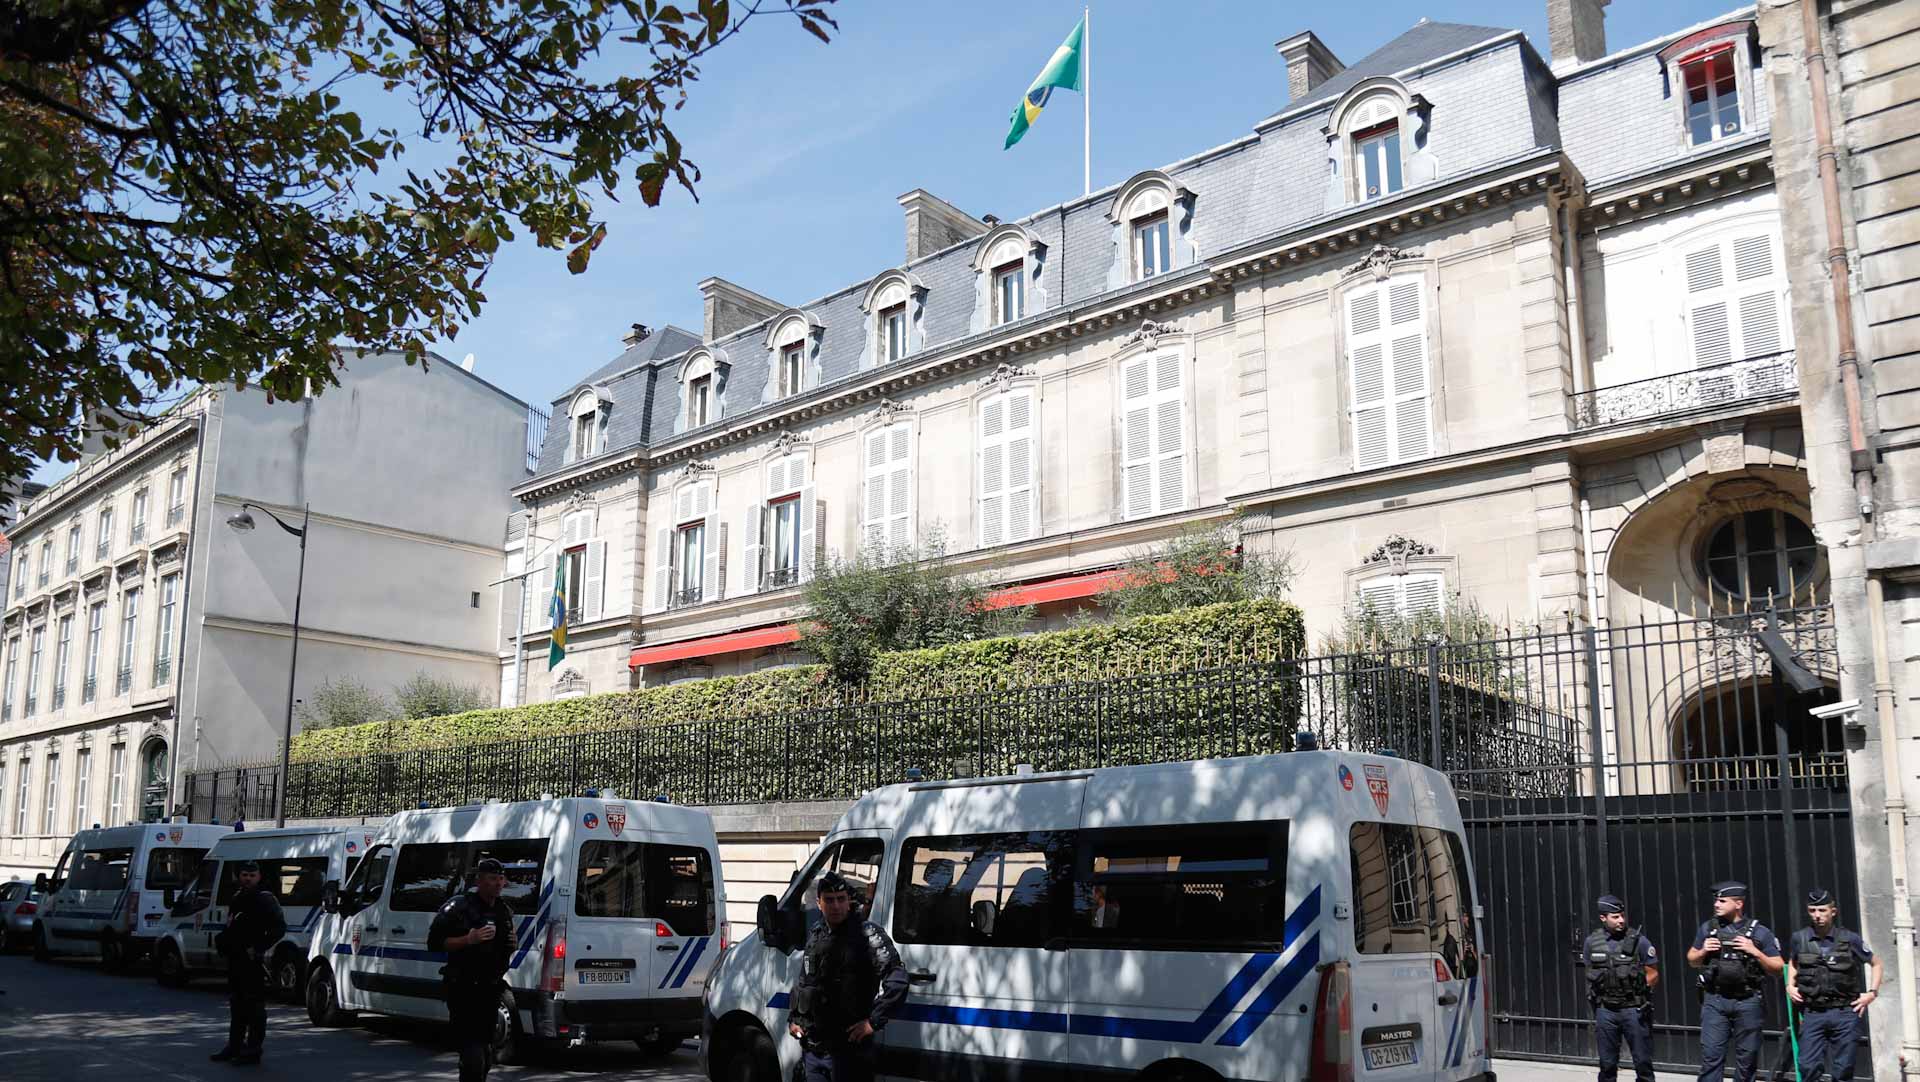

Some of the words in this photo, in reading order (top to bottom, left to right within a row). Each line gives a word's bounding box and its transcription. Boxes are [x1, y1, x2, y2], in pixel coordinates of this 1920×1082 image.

[1369, 780, 1388, 795] CRS
[607, 814, 625, 824] CRS
[1380, 1030, 1413, 1041] MASTER
